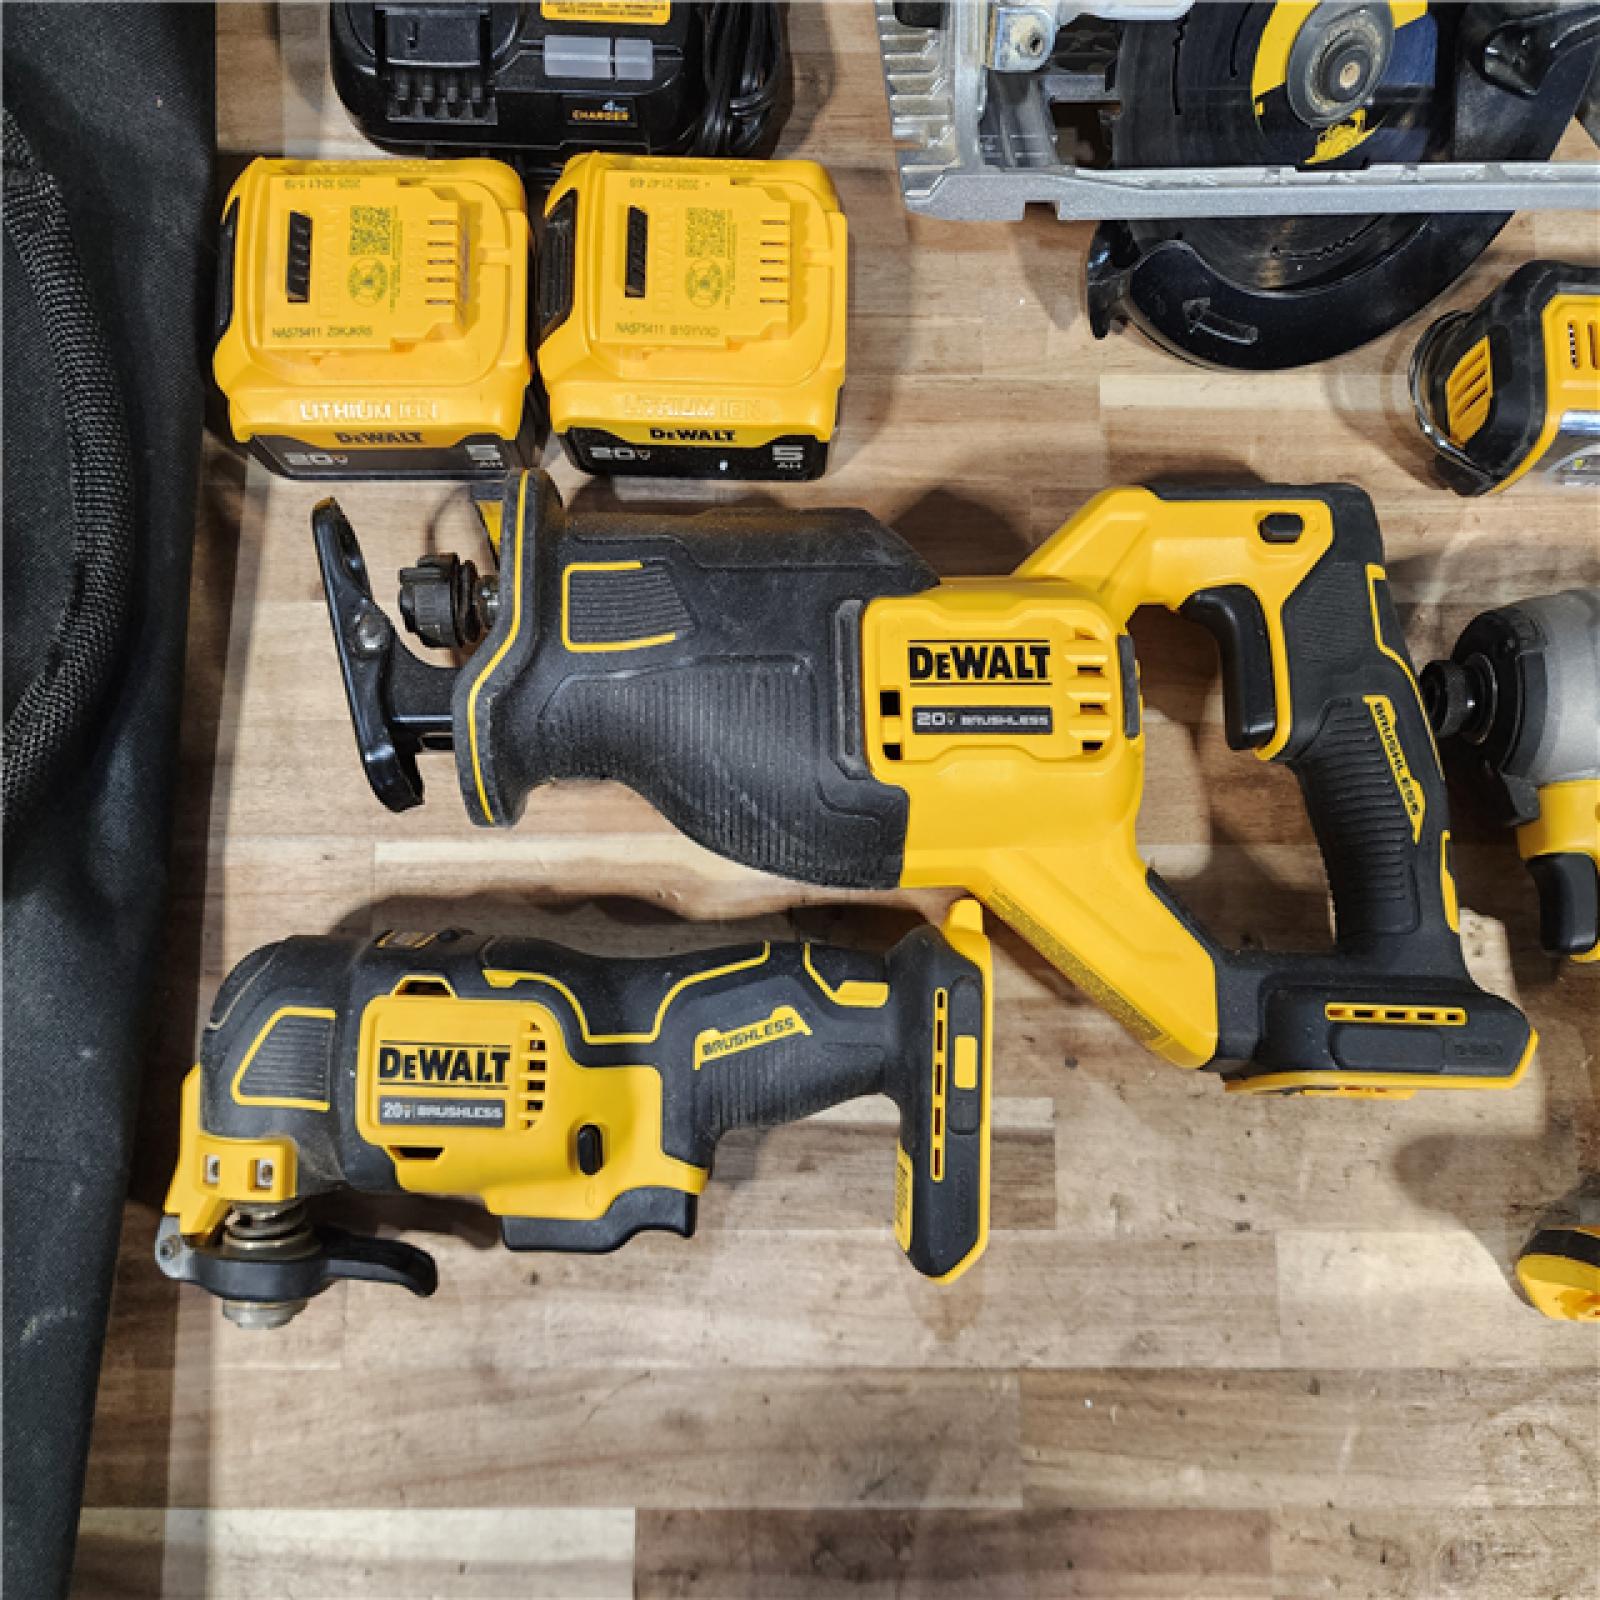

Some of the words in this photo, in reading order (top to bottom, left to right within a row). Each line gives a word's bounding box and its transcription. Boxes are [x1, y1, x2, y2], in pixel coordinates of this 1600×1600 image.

[300, 402, 391, 420] LITHIUM
[908, 645, 1051, 679] DEWALT
[959, 714, 1049, 727] BRUSHLESS
[1374, 702, 1421, 816] BRUSHLESS
[702, 1016, 796, 1056] BRUSHLESS
[379, 1046, 511, 1083] DEWALT
[416, 1104, 503, 1120] BRUSHLESS
